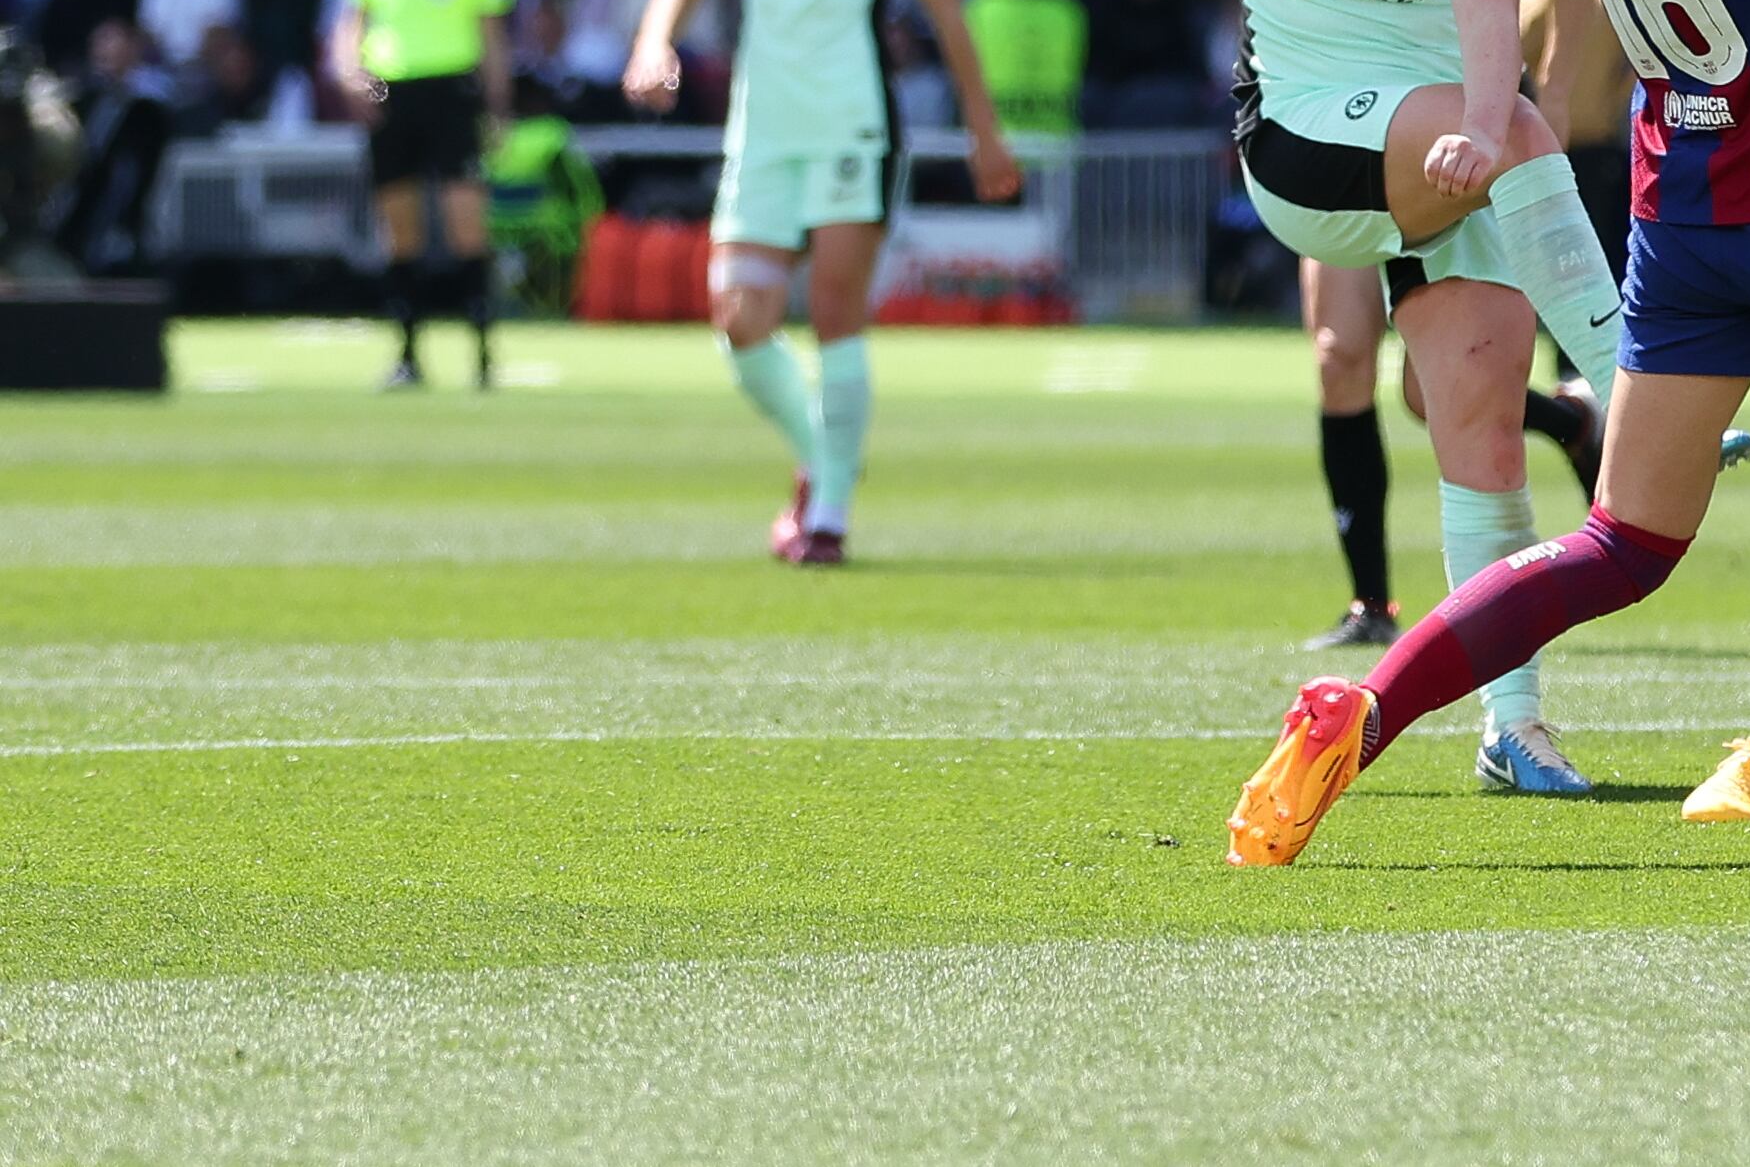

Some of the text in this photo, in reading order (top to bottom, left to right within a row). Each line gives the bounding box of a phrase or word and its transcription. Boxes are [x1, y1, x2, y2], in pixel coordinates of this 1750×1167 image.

[1686, 94, 1730, 112] UNHCR
[1684, 110, 1734, 125] ACNUR
[1505, 540, 1567, 570] BARÇA
